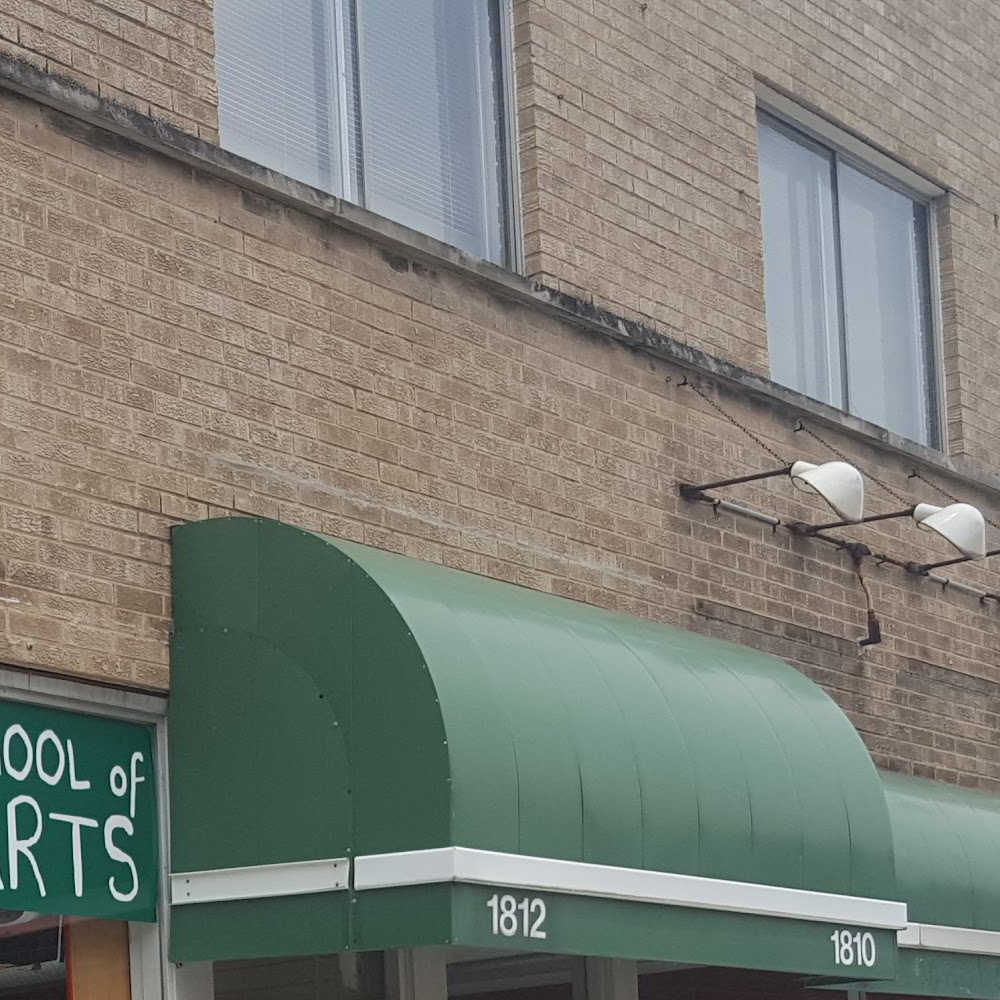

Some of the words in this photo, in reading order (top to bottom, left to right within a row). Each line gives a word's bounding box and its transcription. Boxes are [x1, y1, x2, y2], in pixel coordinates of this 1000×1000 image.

[109, 751, 146, 818] of
[486, 893, 547, 939] 1812
[830, 929, 876, 967] 1810
